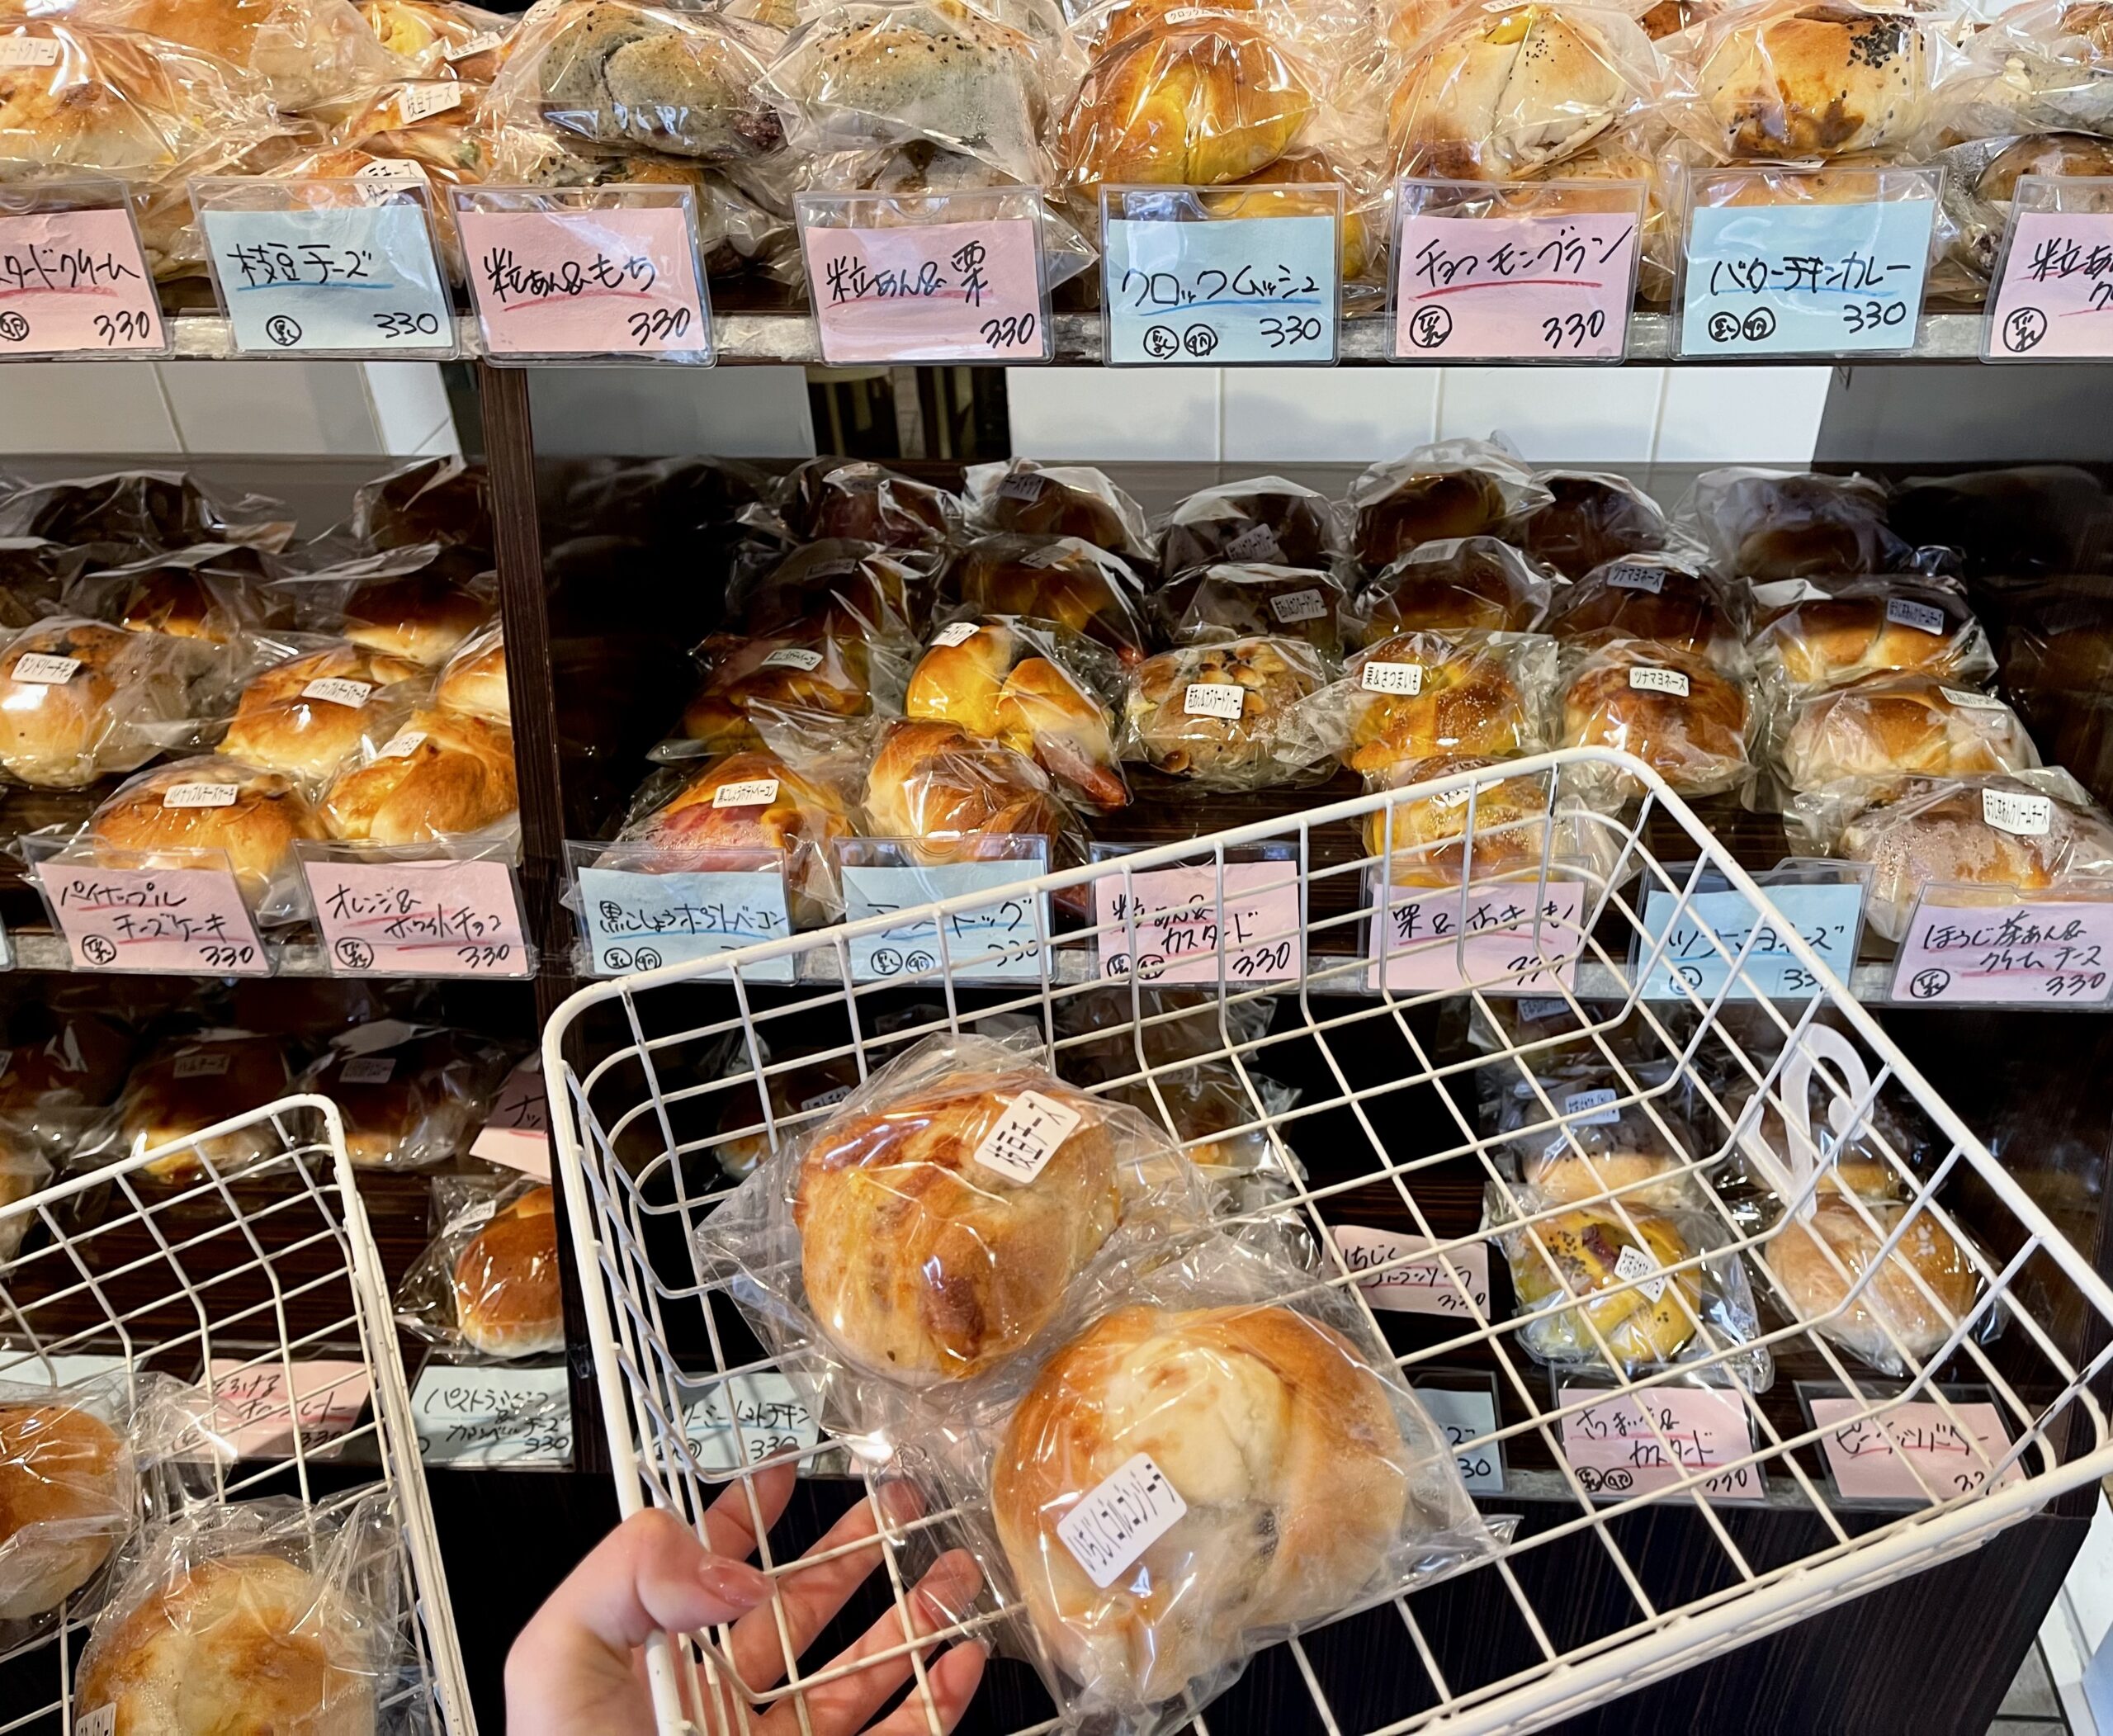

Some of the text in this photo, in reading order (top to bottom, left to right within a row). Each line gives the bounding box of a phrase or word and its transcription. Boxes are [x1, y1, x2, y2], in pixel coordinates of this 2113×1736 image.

[0, 243, 141, 290] タードクリーム
[227, 242, 373, 285] 枝豆チーズ
[484, 247, 656, 303] 粒あん&もち
[826, 240, 988, 307] 粒あん&栗
[1710, 251, 1912, 296] バターチキンカレー
[2027, 238, 2113, 281] 粒あ
[1122, 264, 1321, 308] クロックムッシュ
[93, 310, 150, 346] 330
[373, 312, 439, 339] 330
[627, 308, 691, 345] 330
[980, 314, 1036, 348] 330
[1259, 315, 1322, 348] 330
[1542, 309, 1605, 349] 330
[1843, 300, 1907, 333] 330
[1364, 665, 1419, 689] 栗&さつまいも
[1633, 669, 1687, 693] ツナマヨネーズ
[60, 880, 187, 907] パイナップル
[325, 884, 422, 920] オレンジ&
[112, 913, 227, 943] チーズケーキ
[1160, 911, 1259, 954] カスタード
[1923, 910, 2087, 948] ほうじ茶あん&
[199, 946, 254, 967] 330
[457, 944, 510, 969] 330
[1232, 941, 1291, 977] 330
[2045, 972, 2106, 996] 330
[985, 1096, 1067, 1172] 枝豆チーズ
[524, 1436, 570, 1455] 330
[1457, 1458, 1491, 1479] 30
